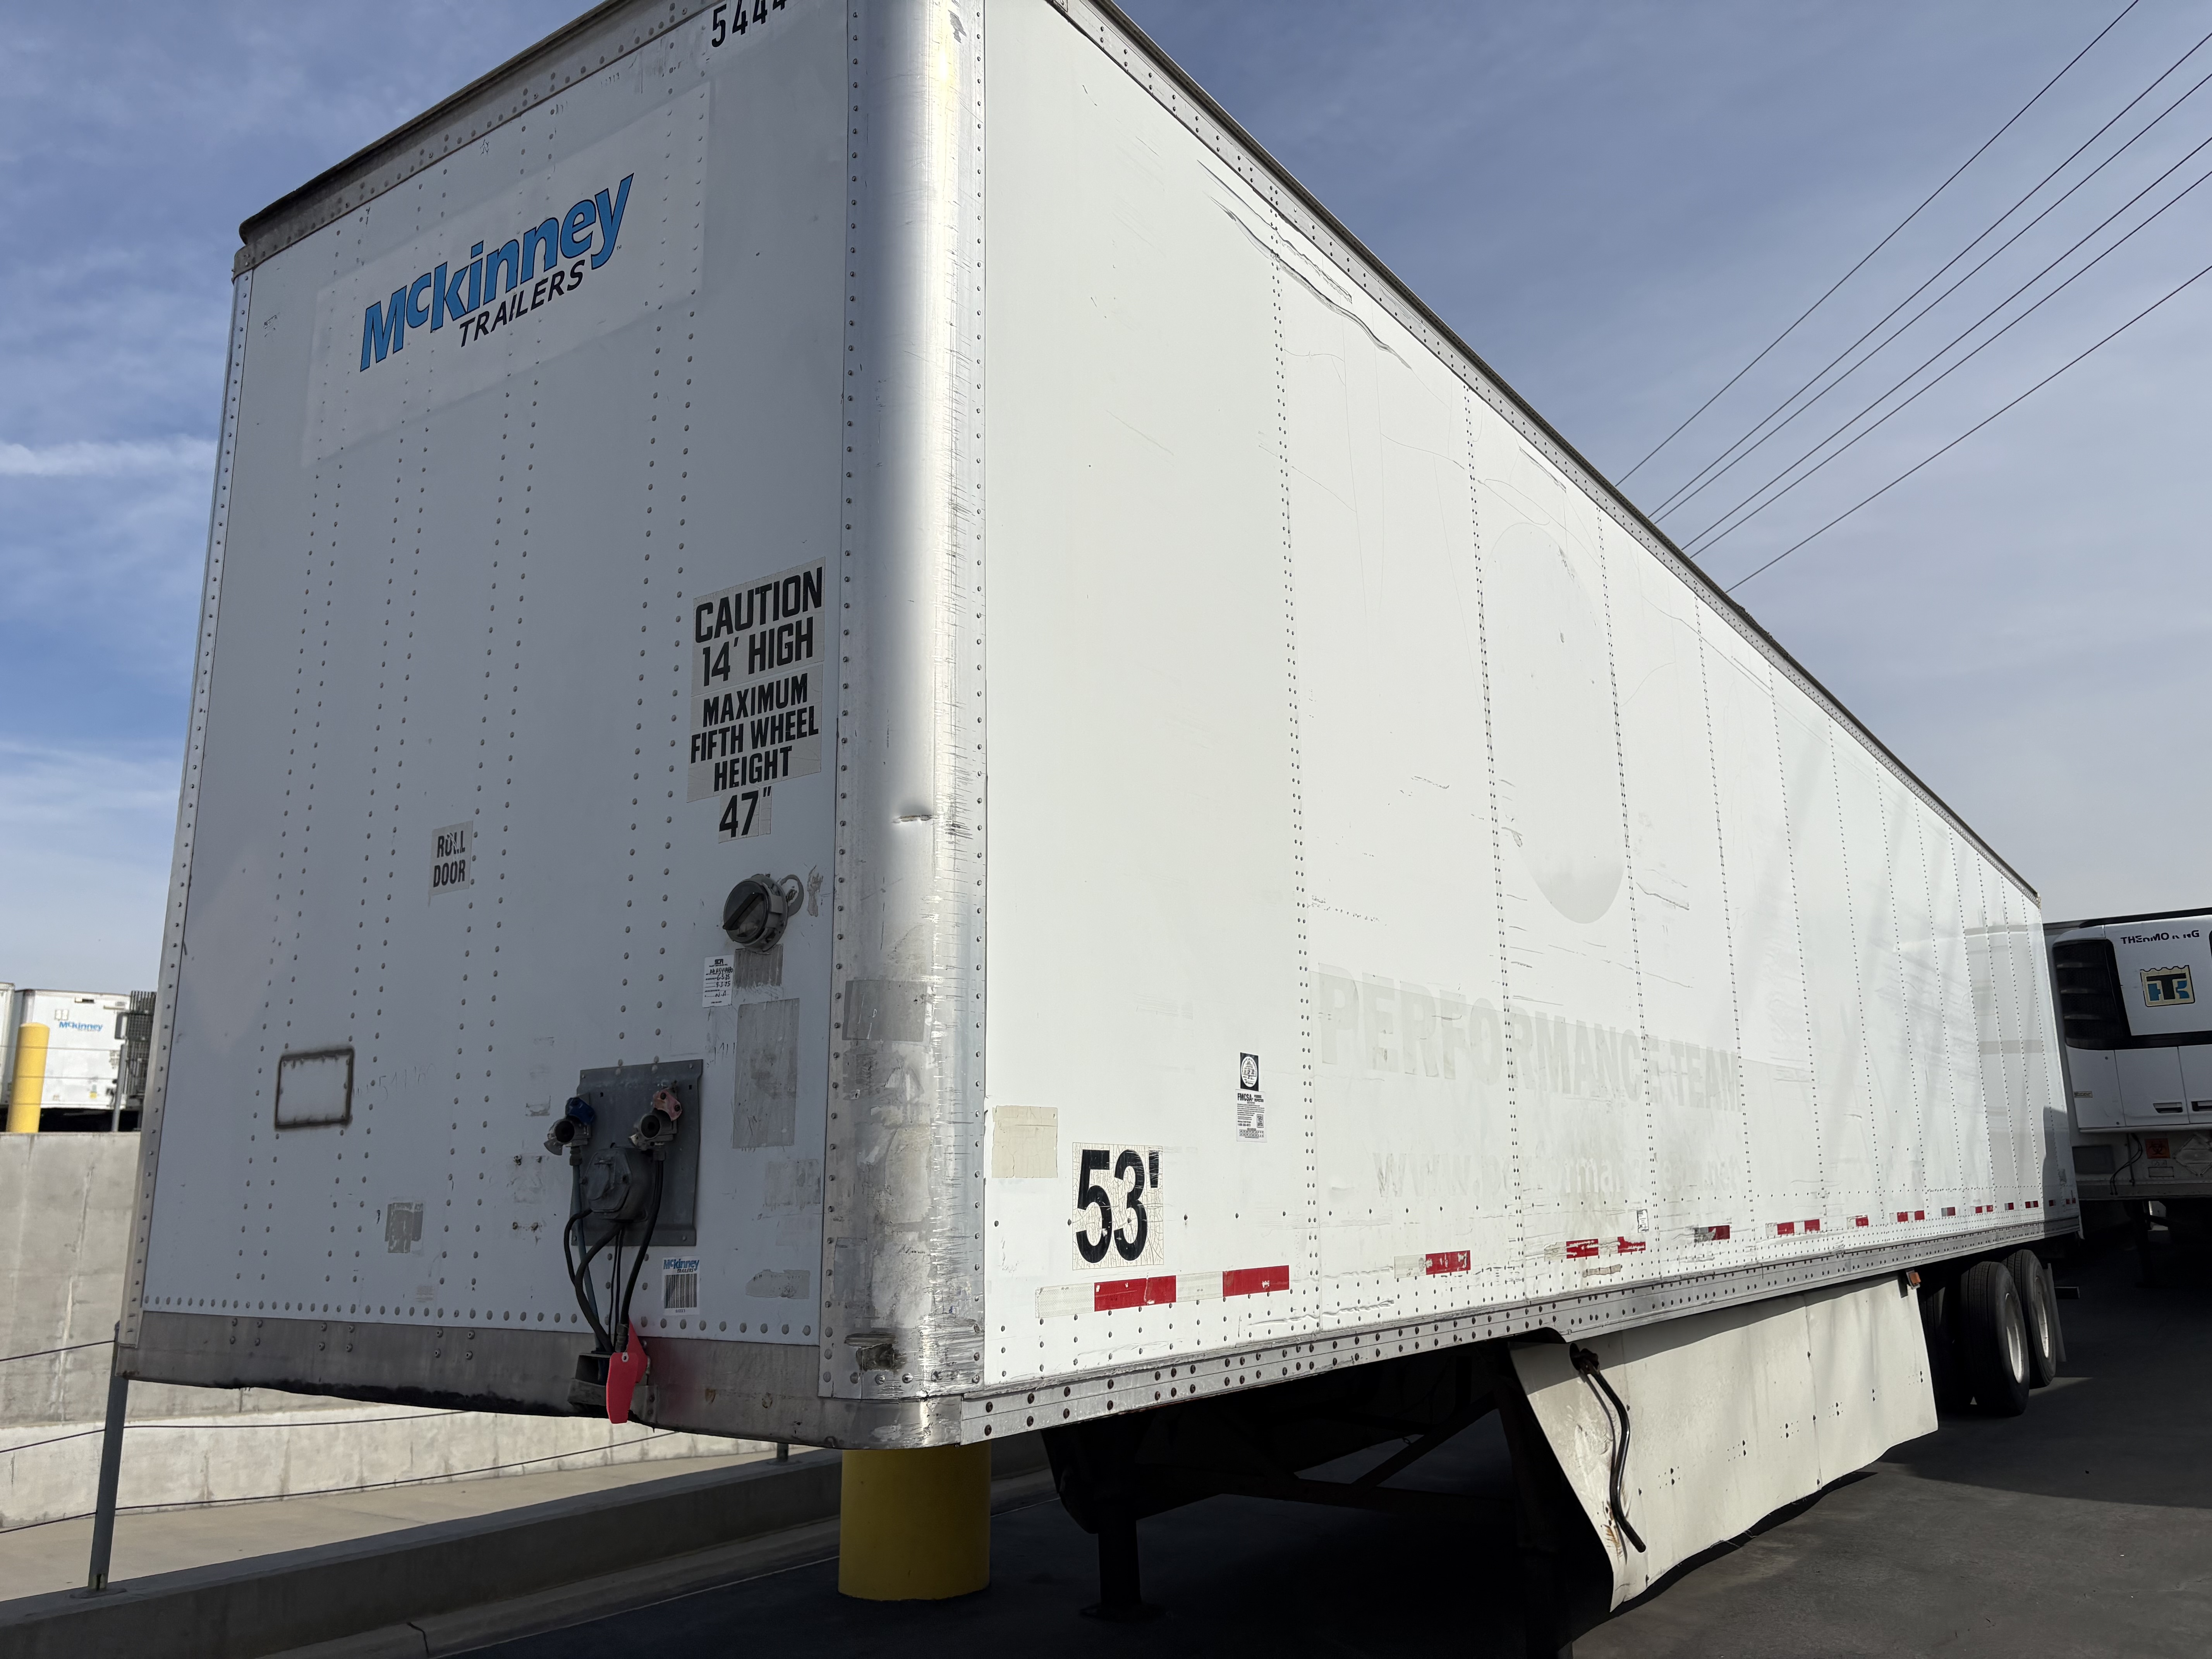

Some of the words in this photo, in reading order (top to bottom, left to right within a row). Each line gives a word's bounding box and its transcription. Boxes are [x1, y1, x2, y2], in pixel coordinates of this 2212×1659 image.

[711, 0, 787, 47] 544
[460, 260, 584, 347] TRAILERS
[696, 567, 823, 643] CAUTION
[703, 637, 739, 687] 14'
[748, 617, 814, 675] HIGH
[703, 673, 808, 728] MAXIMUM
[690, 723, 744, 764] FIFTH
[750, 706, 819, 750] WHEEL
[714, 746, 792, 792] HEIGHT
[719, 786, 771, 838] 47"
[437, 830, 465, 858] ROLL
[433, 859, 465, 888] DOOR
[1318, 962, 1660, 1104] PERFORMANCE
[1076, 1149, 1160, 1263] 53'
